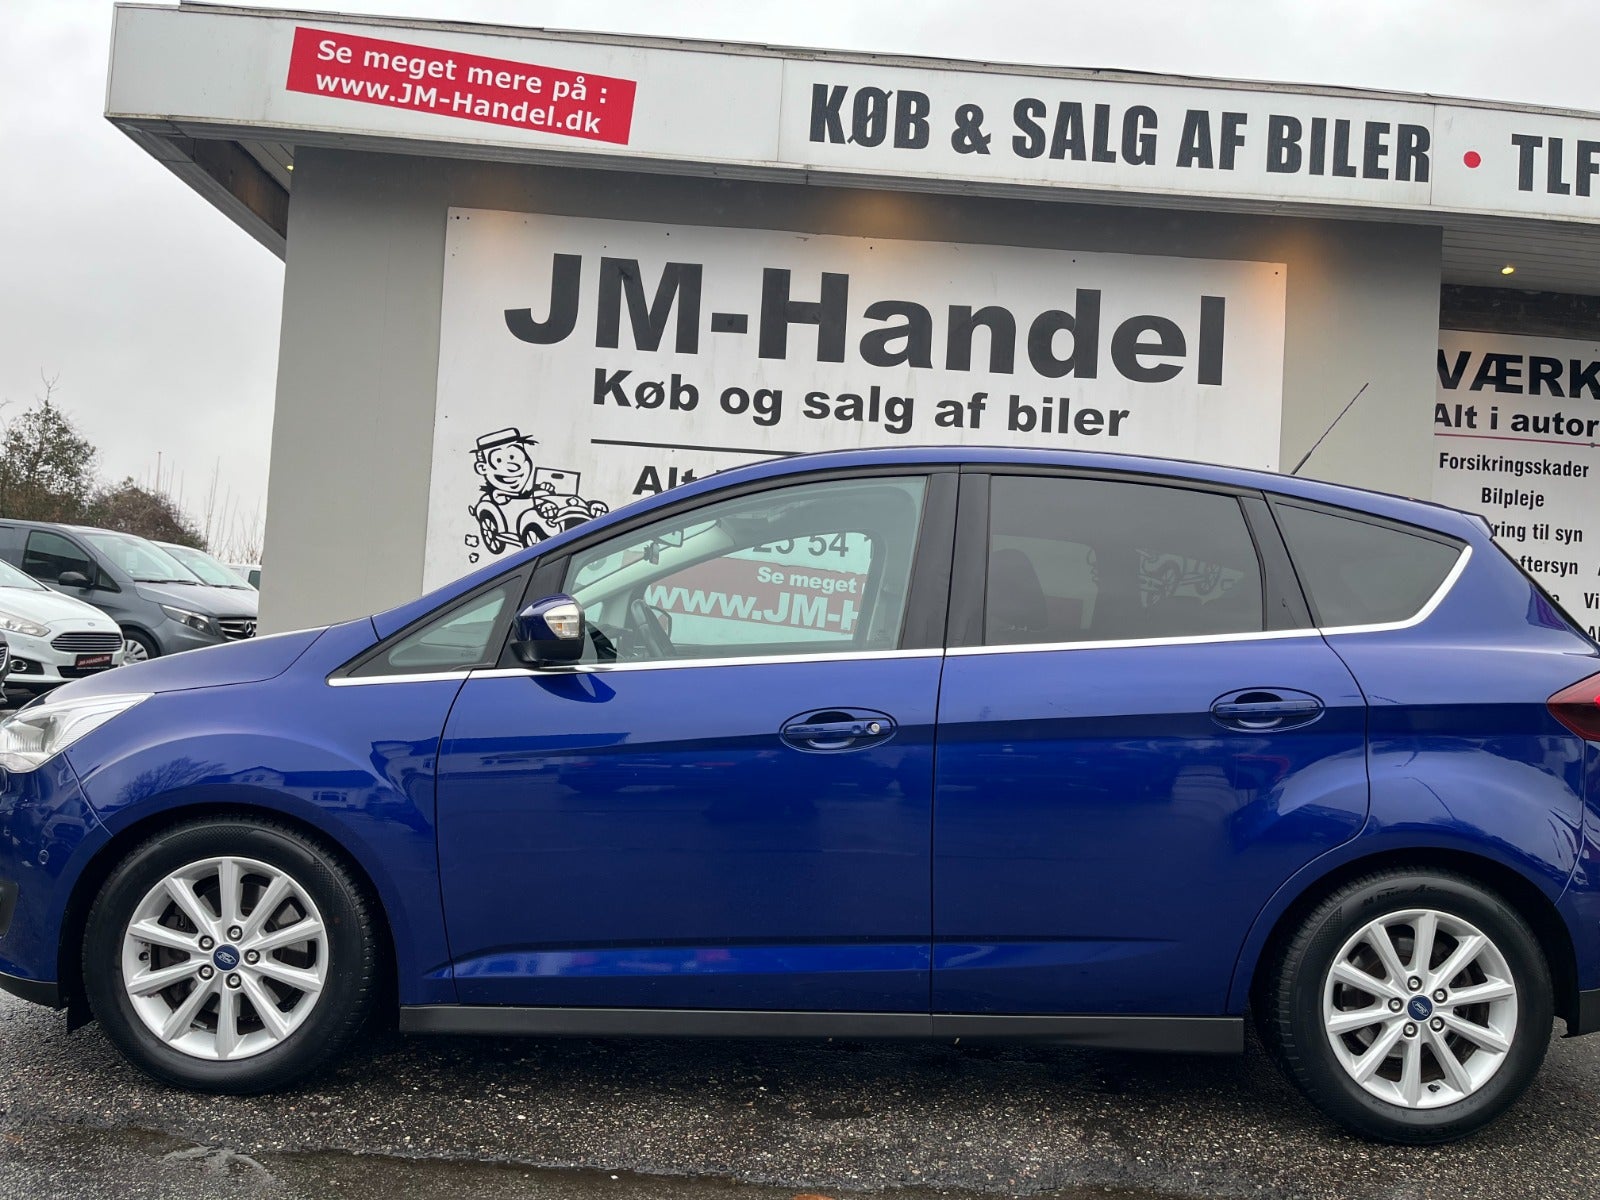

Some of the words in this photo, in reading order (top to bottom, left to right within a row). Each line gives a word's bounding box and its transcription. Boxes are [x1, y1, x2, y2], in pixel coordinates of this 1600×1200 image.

[317, 39, 353, 64] Se
[362, 50, 458, 80] meget
[467, 63, 543, 94] mere
[552, 75, 588, 103] på
[315, 72, 602, 134] www.JM-Handel.dk
[808, 83, 931, 150] KØB
[950, 103, 992, 155] &
[1012, 97, 1159, 166] SALG
[1175, 109, 1248, 171] AF
[1266, 114, 1431, 183] BILER
[503, 252, 1226, 386] JM-Handel
[1437, 348, 1600, 400] VÆRK
[593, 367, 700, 411] Køb
[719, 386, 783, 427] og
[802, 386, 915, 434] salg
[934, 392, 989, 429] af
[1007, 394, 1130, 437] biler
[1434, 403, 1478, 429] Alt
[1490, 406, 1498, 430] i
[1511, 411, 1600, 437] autor
[1439, 452, 1590, 478] Forsikringsskader
[1481, 487, 1545, 510] Bilpleje
[808, 531, 849, 558] 54
[1491, 521, 1526, 542] ring
[1532, 523, 1550, 540] til
[1555, 528, 1583, 545] syn
[756, 566, 784, 585] Se
[789, 573, 857, 595] meget
[1515, 555, 1579, 578] ftersyn
